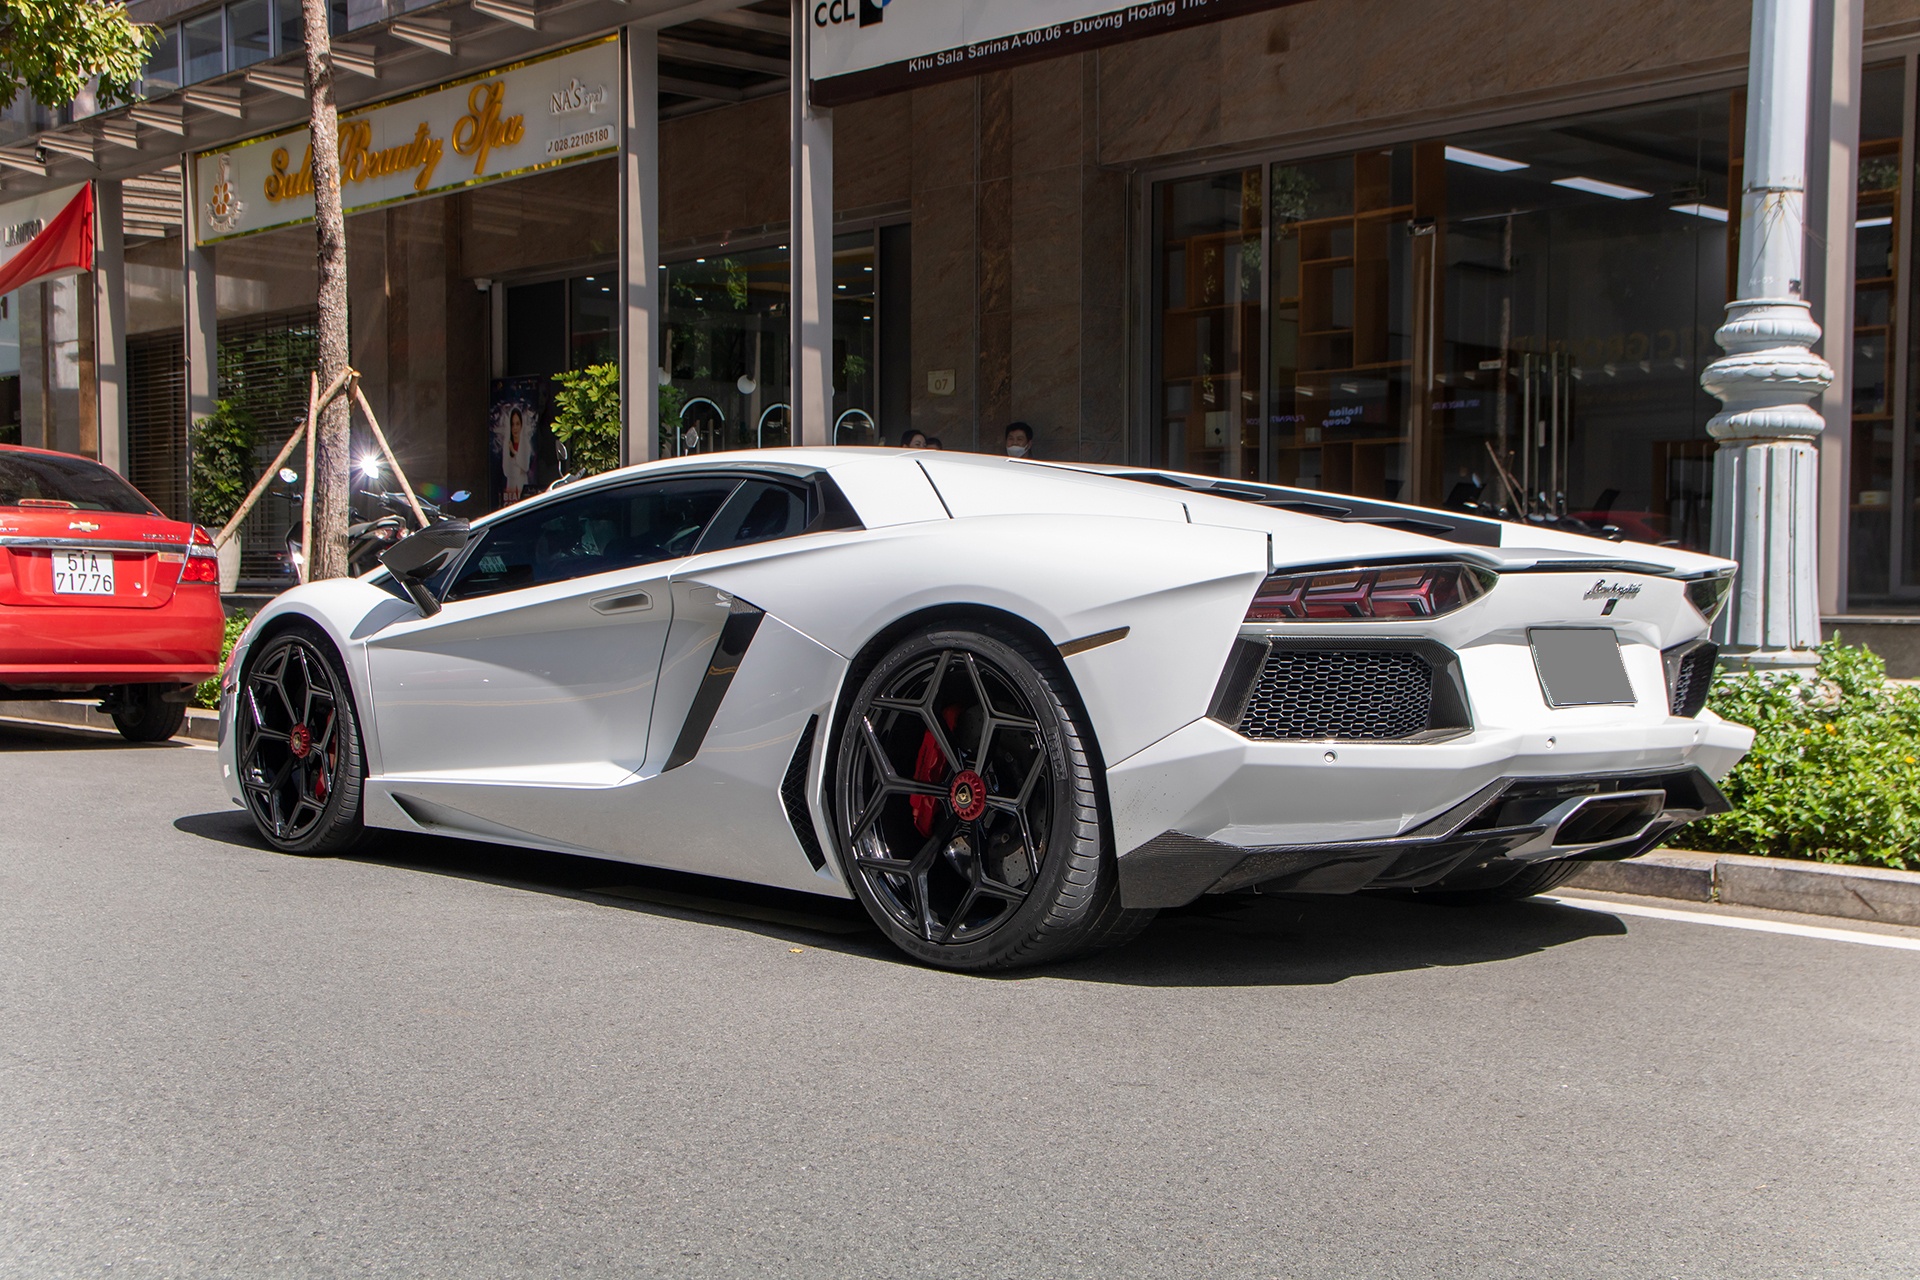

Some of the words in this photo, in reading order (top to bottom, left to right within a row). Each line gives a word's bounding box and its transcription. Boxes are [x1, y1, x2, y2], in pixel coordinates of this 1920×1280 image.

[814, 0, 855, 28] CCL
[908, 57, 933, 73] Khu
[936, 49, 964, 66] Sala
[968, 41, 1009, 59] Sarina
[1011, 26, 1061, 50] A-00.06
[337, 119, 444, 191] Beauty
[452, 80, 526, 175] Spa
[554, 128, 609, 152] 028.22105180
[934, 378, 949, 391] 07
[68, 553, 99, 572] 51A
[56, 572, 113, 592] 717.76
